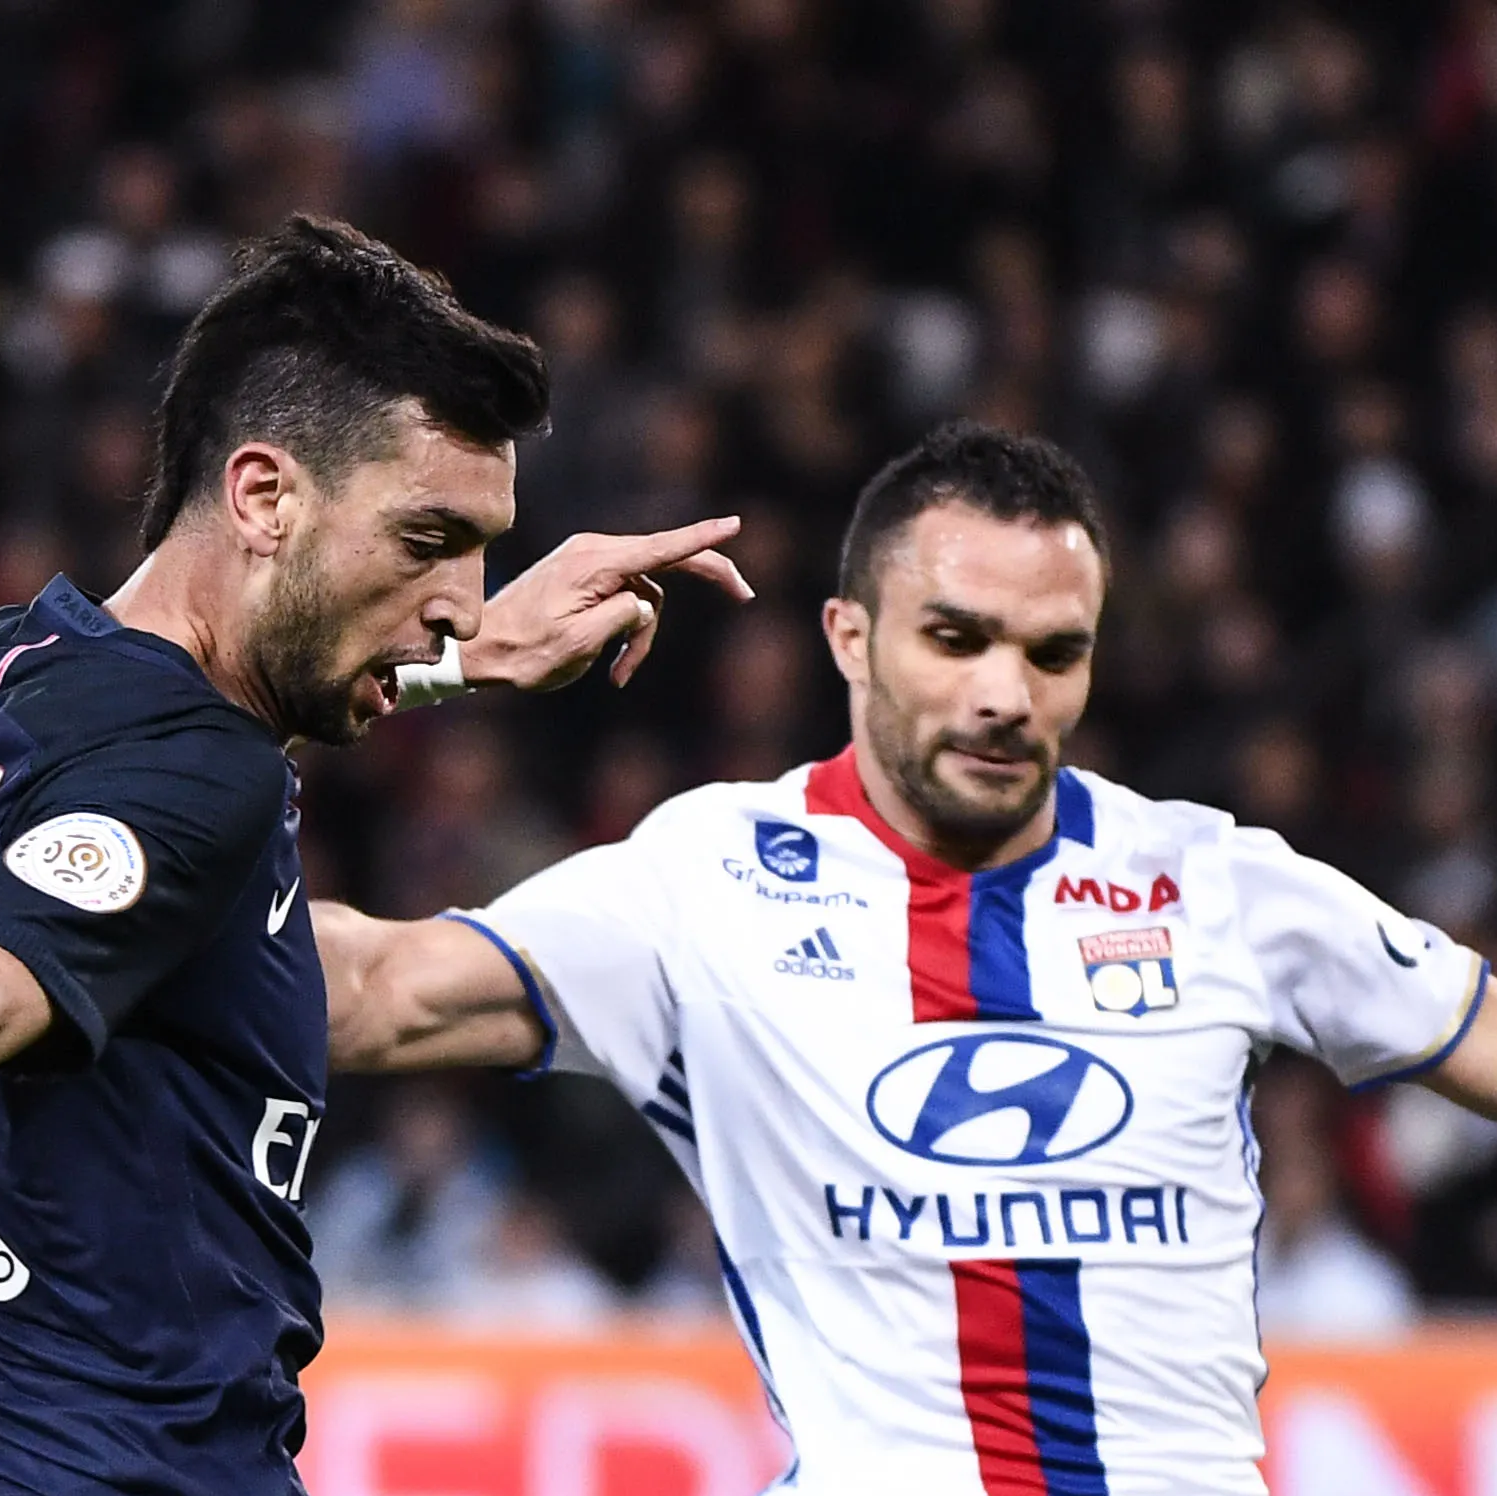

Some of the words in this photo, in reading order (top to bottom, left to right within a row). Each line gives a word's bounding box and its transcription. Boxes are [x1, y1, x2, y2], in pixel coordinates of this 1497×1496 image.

[773, 956, 856, 981] adidas
[1091, 959, 1178, 1012] OL
[824, 1183, 1188, 1247] HYUNDAI
